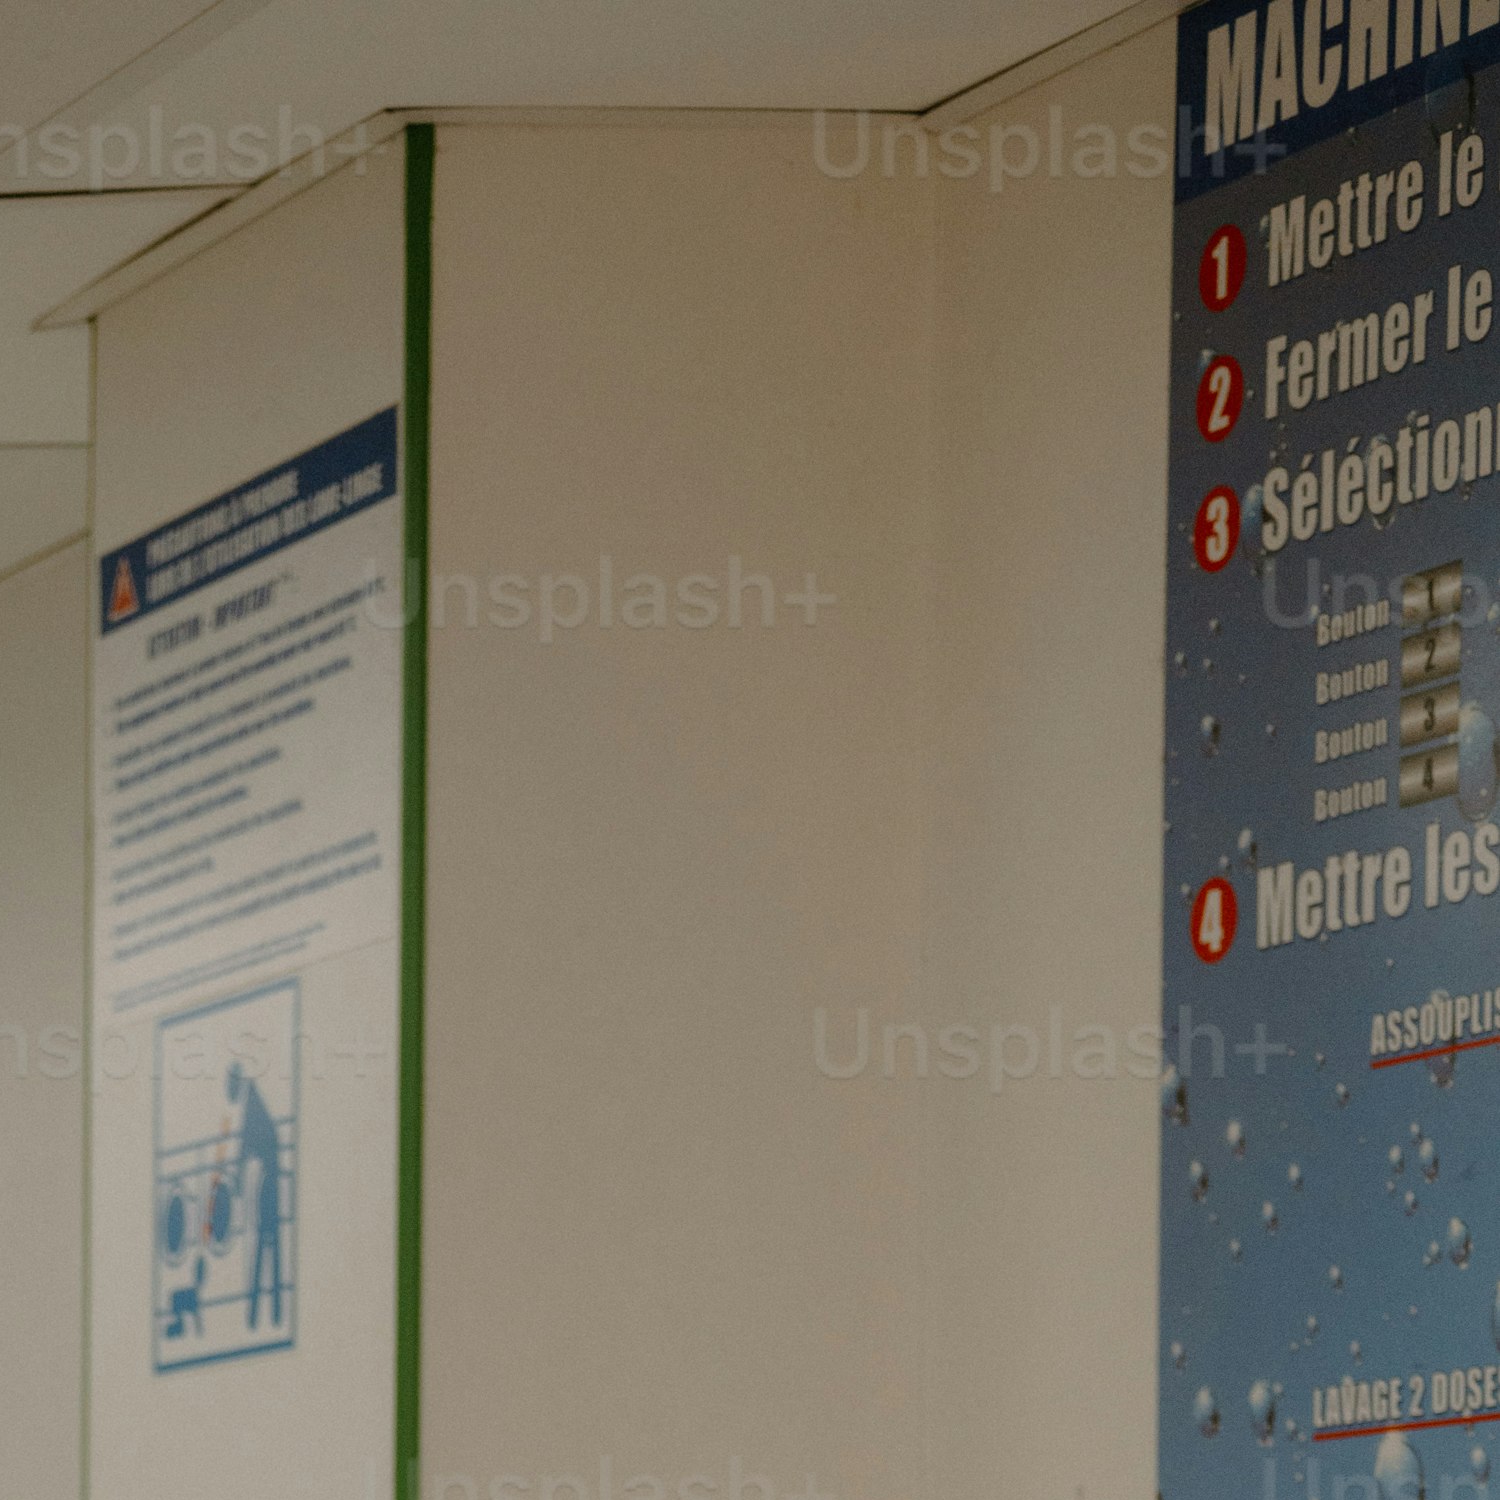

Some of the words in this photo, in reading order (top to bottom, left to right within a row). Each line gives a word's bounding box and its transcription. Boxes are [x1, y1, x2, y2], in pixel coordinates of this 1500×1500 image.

[1204, 0, 1500, 156] MACHI
[1211, 236, 1228, 300] 1
[1268, 160, 1423, 287] Mettre
[1438, 131, 1485, 217] le
[1208, 365, 1231, 432] 2
[1265, 289, 1433, 419] Fermer
[1446, 264, 1493, 350] le
[1206, 496, 1229, 562] 3
[1261, 402, 1500, 551] Séléction
[1316, 600, 1389, 647] Bouton
[1316, 658, 1388, 705] Bouton
[1425, 638, 1437, 673] 2
[1314, 717, 1387, 764] Bouton
[1313, 776, 1386, 822] Bouton
[1200, 888, 1223, 953] 4
[1256, 847, 1411, 950] Mettre
[1425, 822, 1500, 908] les
[1312, 1376, 1401, 1429] LAVAGE
[1409, 1373, 1424, 1417] 2
[1431, 1365, 1500, 1415] DOSE
